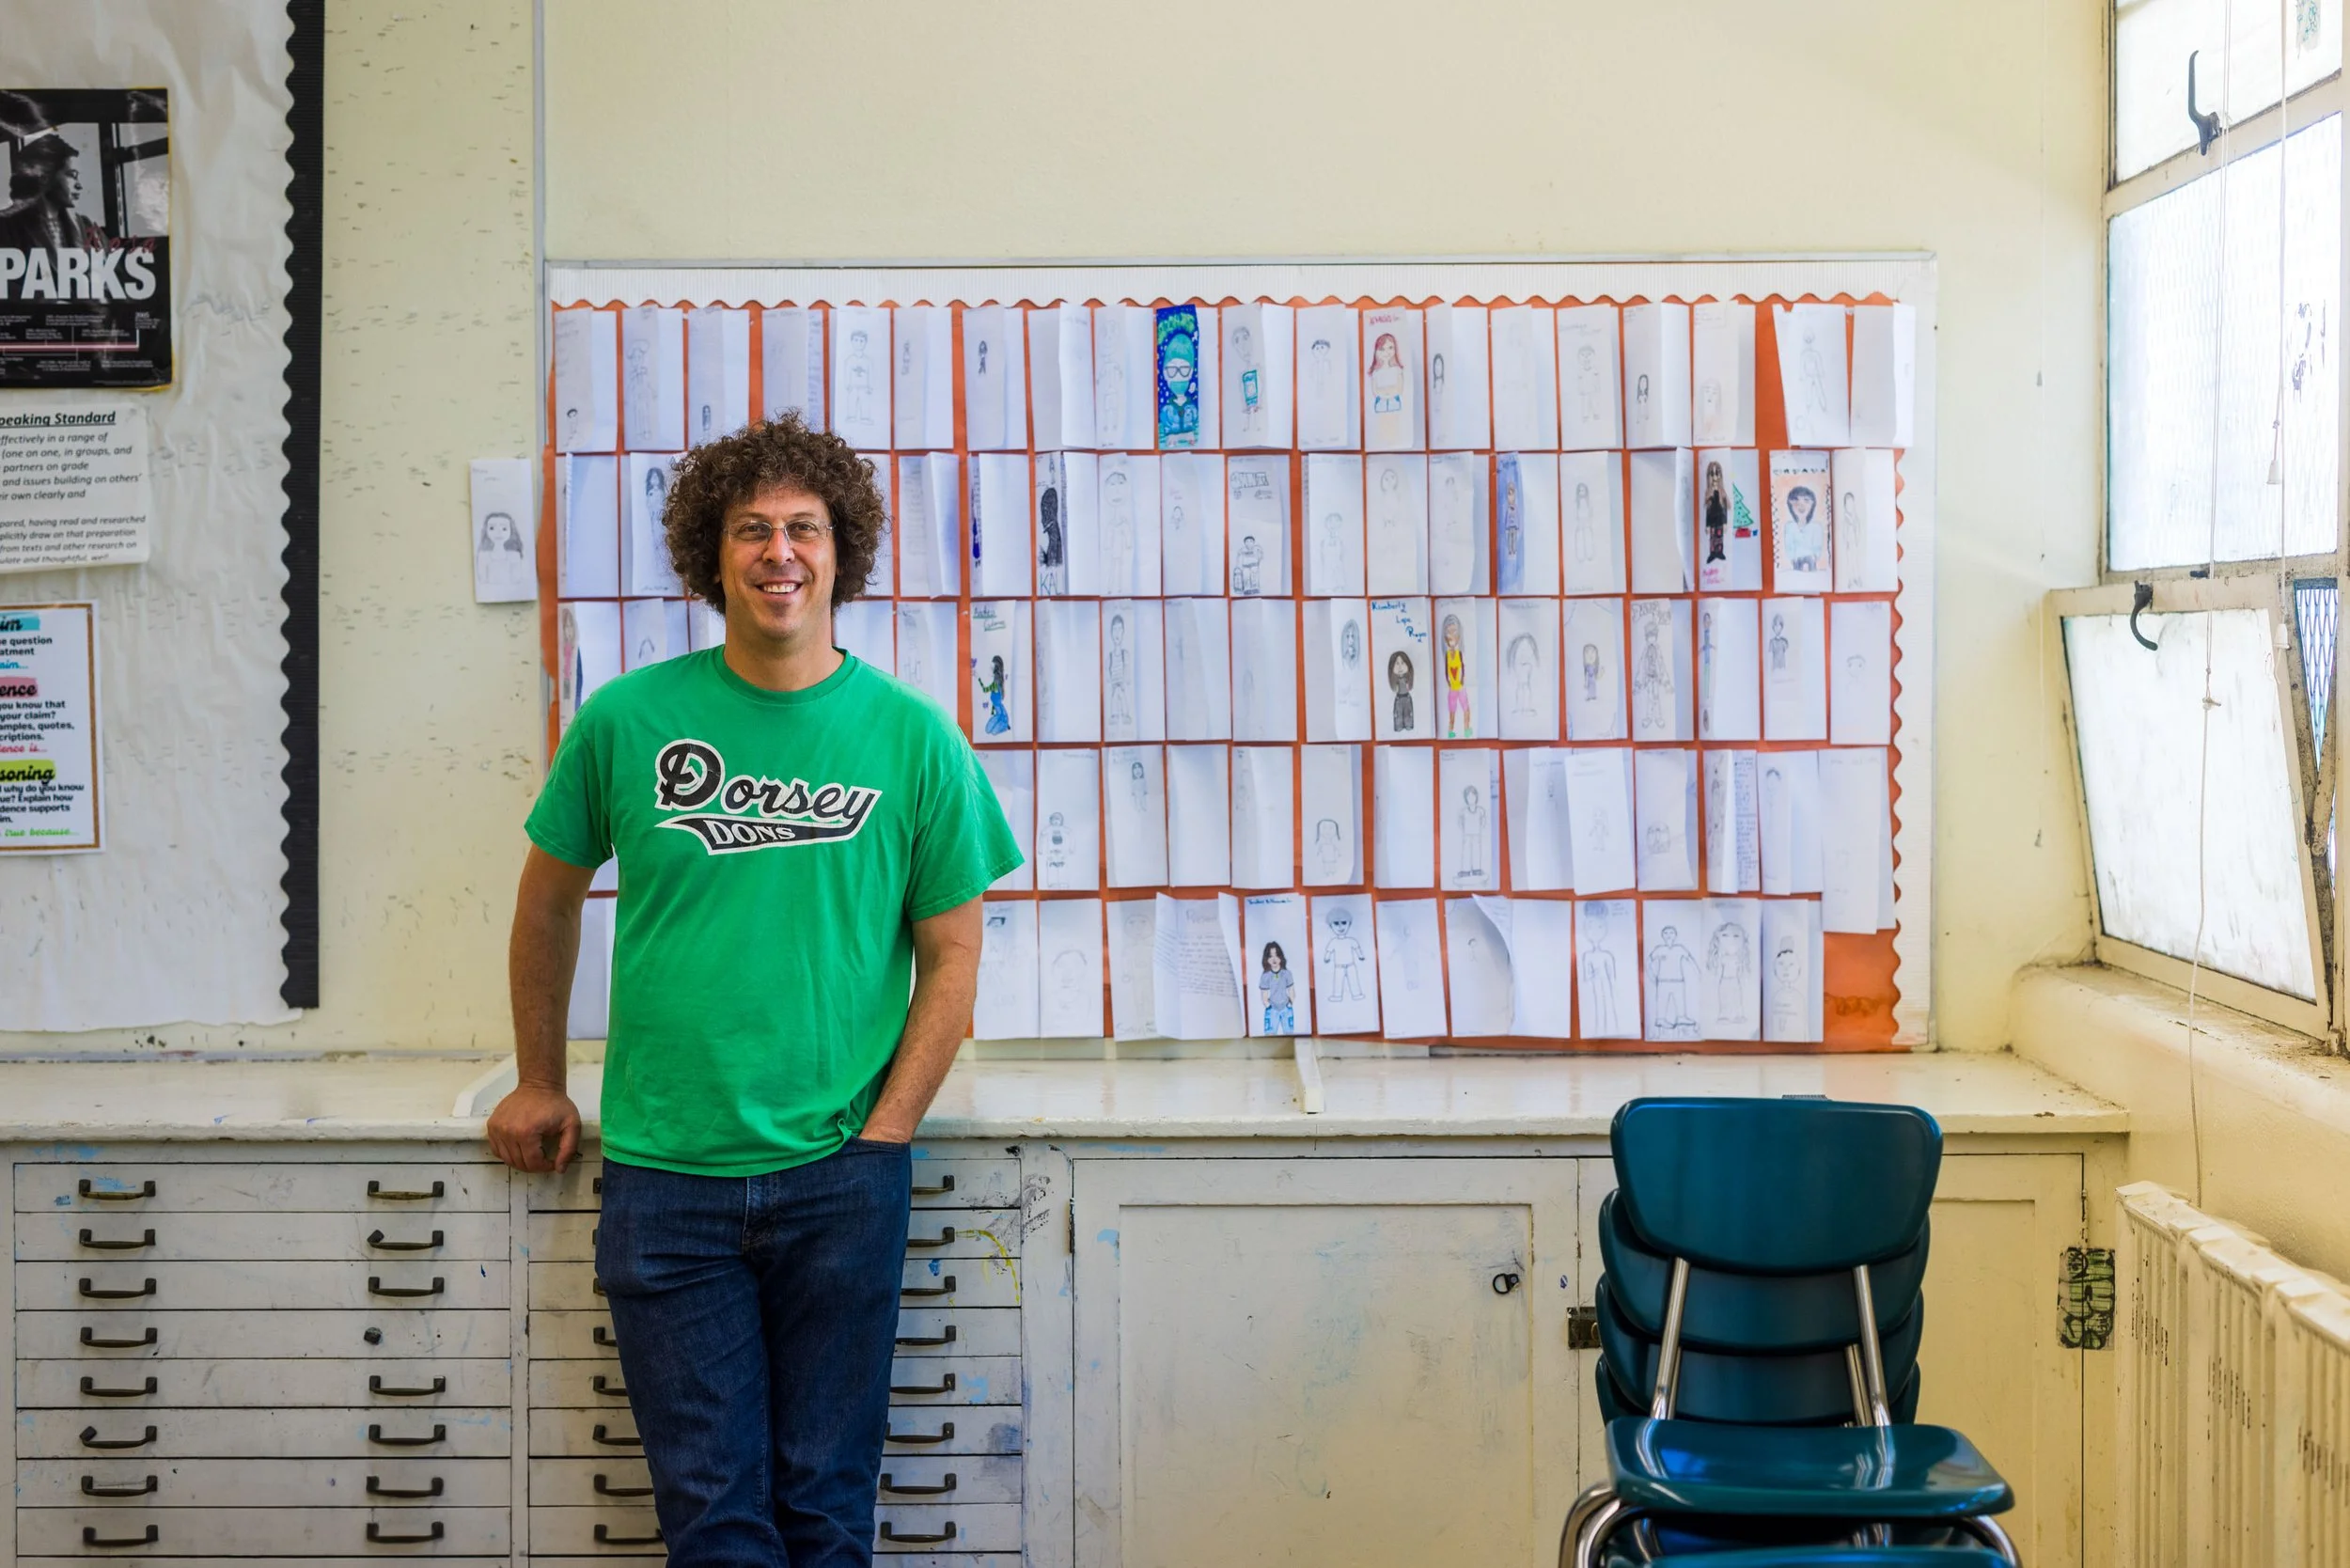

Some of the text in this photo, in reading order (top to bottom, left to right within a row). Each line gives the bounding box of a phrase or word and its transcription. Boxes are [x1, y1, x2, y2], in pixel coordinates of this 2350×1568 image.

[0, 246, 156, 300] PARKS
[55, 411, 117, 424] Standard
[47, 434, 55, 443] in
[68, 434, 95, 444] range
[98, 431, 108, 443] of
[2, 449, 24, 460] (one
[75, 448, 111, 458] groups,
[114, 446, 133, 455] and
[3, 464, 43, 473] partners
[61, 461, 89, 472] grade
[2, 478, 21, 486] and
[24, 477, 51, 486] issues
[54, 475, 92, 485] building
[34, 490, 65, 500] clearly
[68, 489, 86, 498] and
[29, 518, 57, 527] having
[59, 517, 79, 525] read
[100, 514, 146, 524] researched
[86, 529, 136, 539] preparation
[62, 542, 86, 551] other
[87, 541, 124, 550] research
[9, 635, 53, 646] question
[0, 711, 56, 722] your claim?
[38, 722, 75, 731] quotes,
[654, 738, 883, 825] Dorsey
[4, 784, 24, 794] why
[39, 785, 56, 794] you
[18, 794, 52, 804] Explain
[29, 805, 70, 814] supports
[703, 819, 796, 845] DONS
